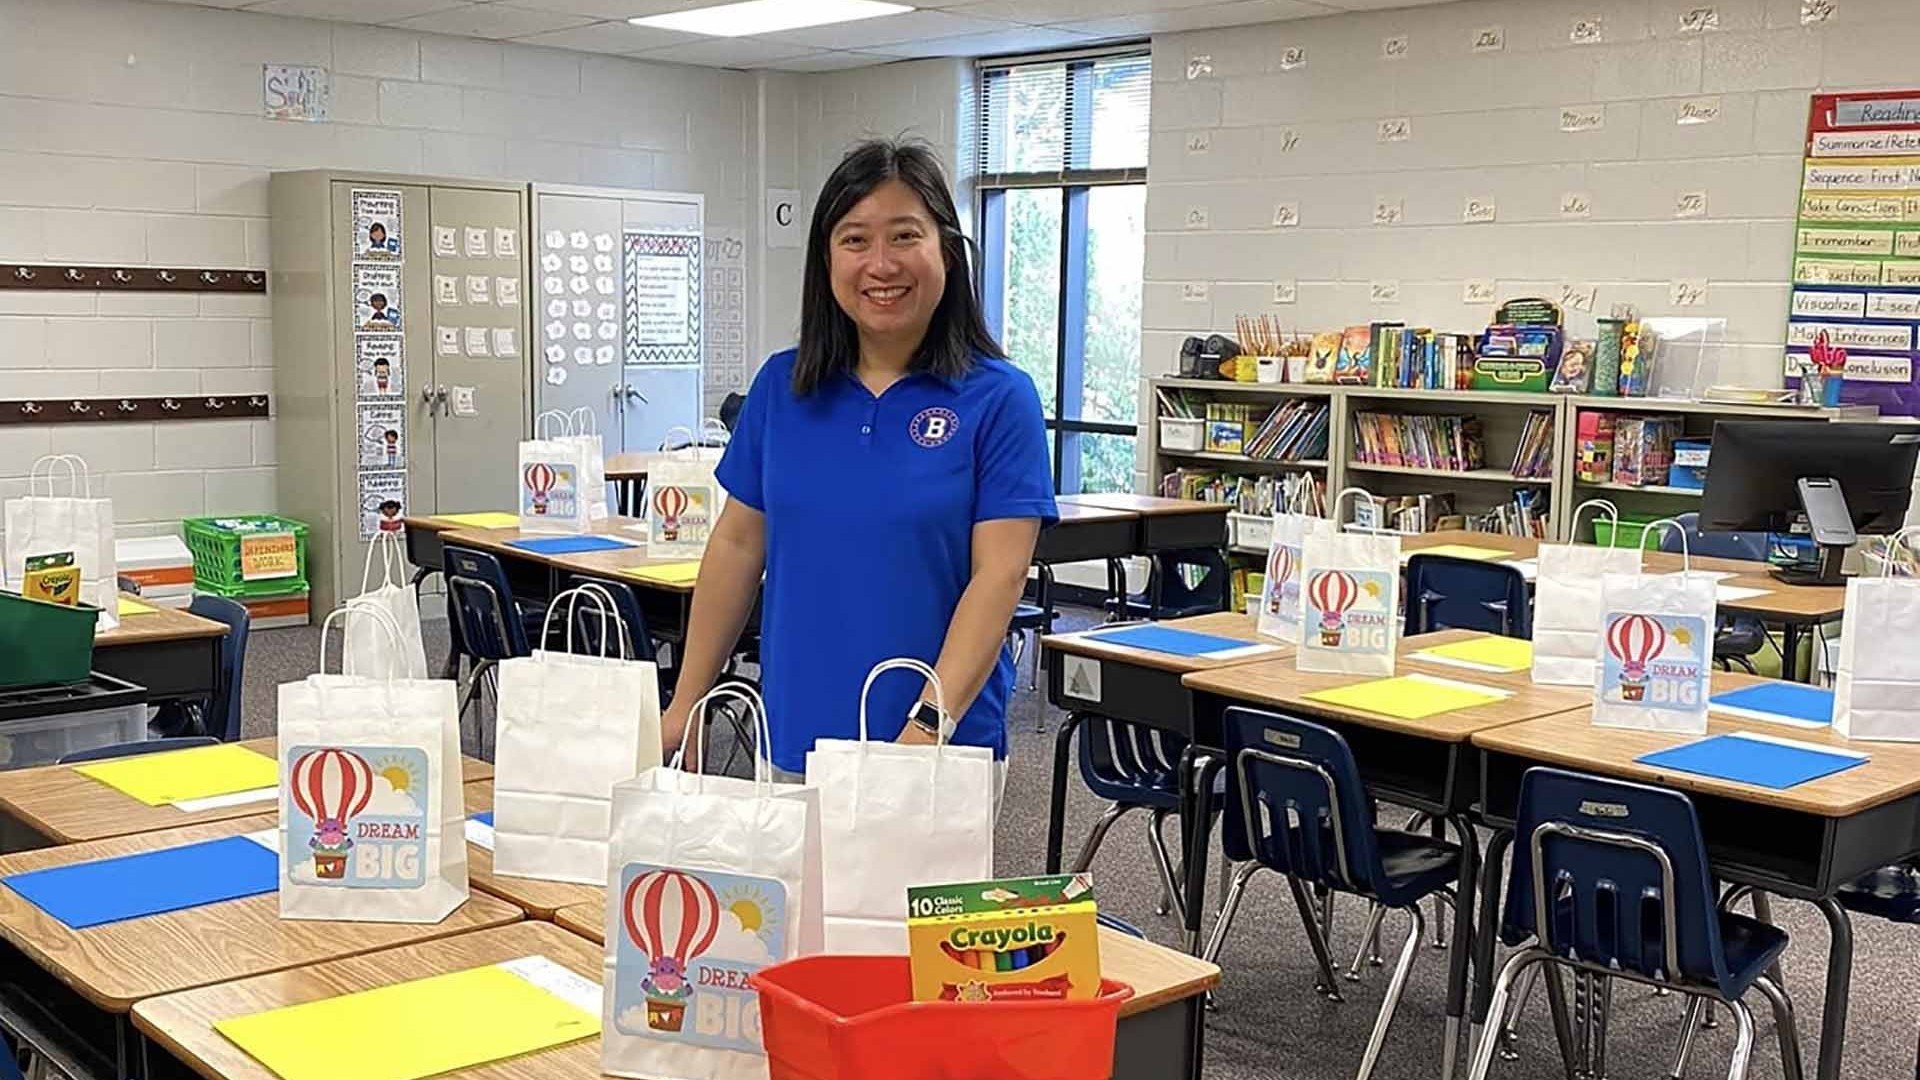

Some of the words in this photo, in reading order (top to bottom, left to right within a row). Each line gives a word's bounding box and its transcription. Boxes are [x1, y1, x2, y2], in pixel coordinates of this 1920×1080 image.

[1818, 133, 1920, 150] Summarize/Rete
[776, 203, 792, 226] C
[1844, 360, 1908, 375] onclusion
[924, 417, 946, 438] B
[1347, 614, 1386, 626] DREAM
[1346, 626, 1386, 648] BIG
[1653, 665, 1698, 678] DREAM
[1651, 679, 1699, 704] BIG
[358, 822, 419, 839] DREAM
[355, 843, 420, 880] BIG
[911, 897, 934, 917] 10
[934, 894, 964, 905] Classic
[934, 905, 964, 915] Colors
[950, 922, 1054, 949] Crayola
[698, 966, 759, 990] DREA
